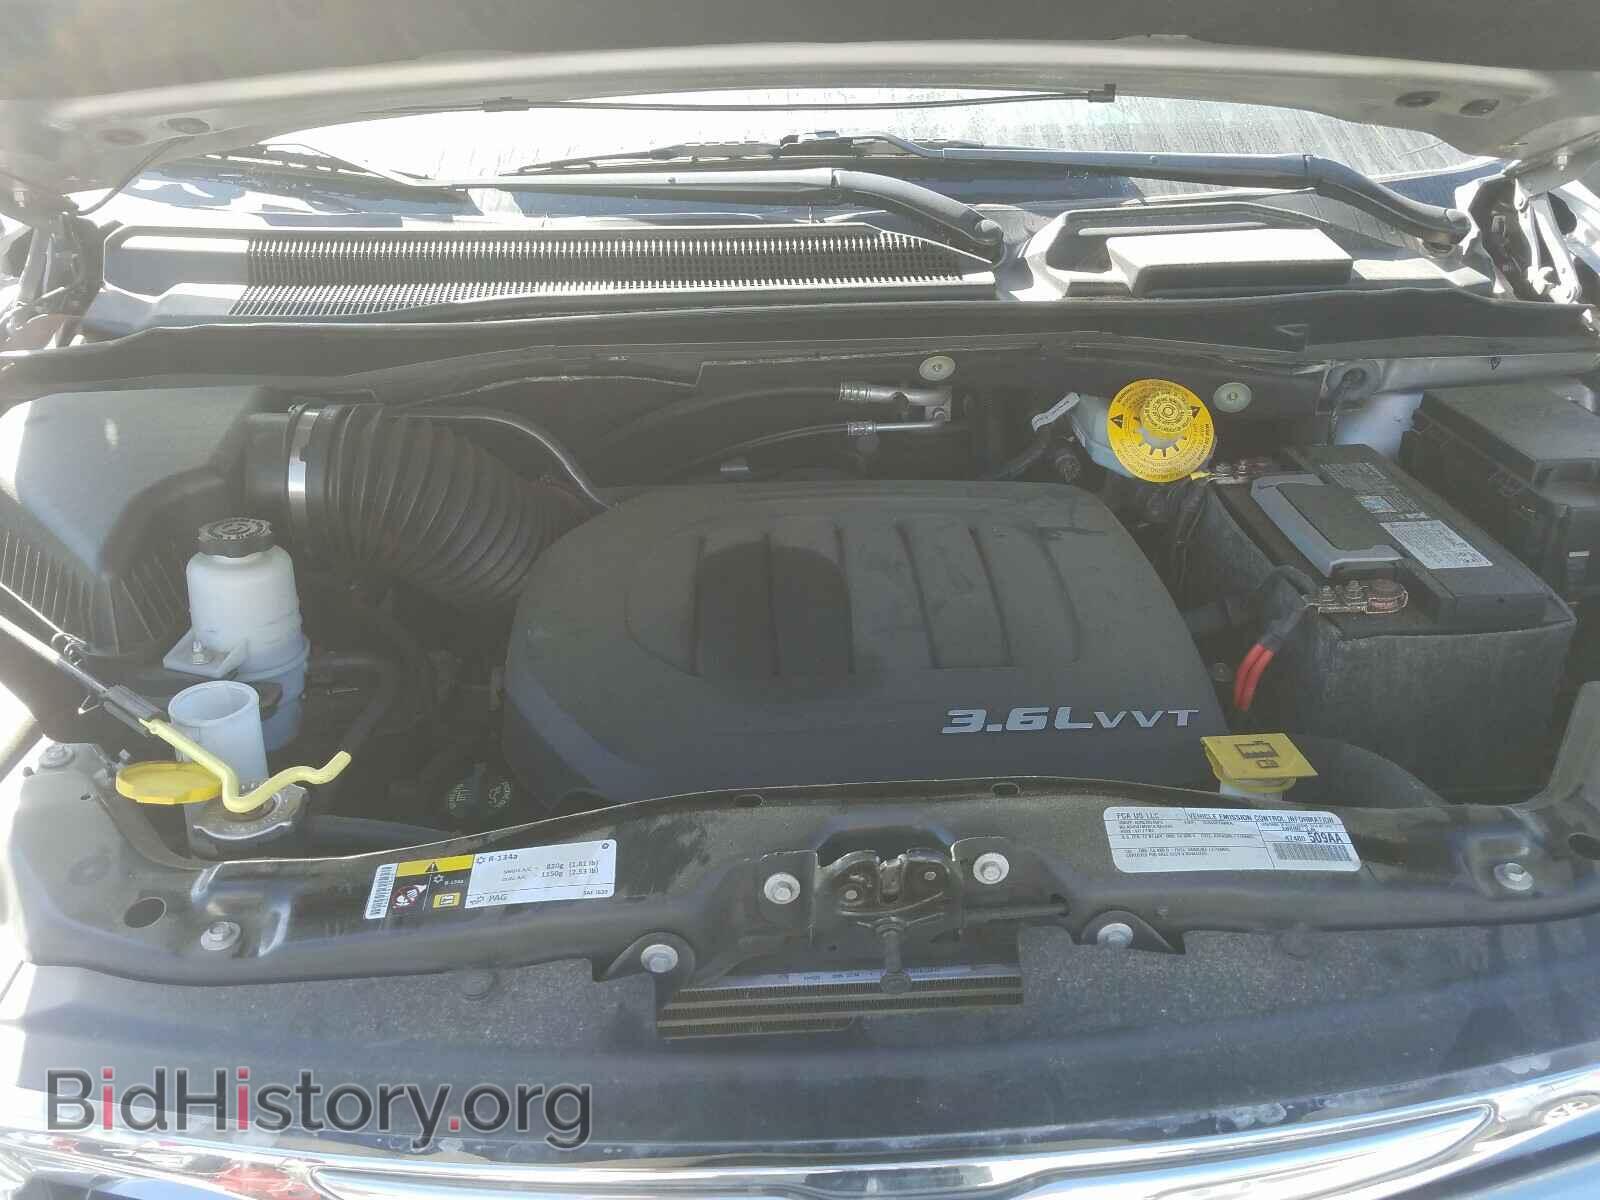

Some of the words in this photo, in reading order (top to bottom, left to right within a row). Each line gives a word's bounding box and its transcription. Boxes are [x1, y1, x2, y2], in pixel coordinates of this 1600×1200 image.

[1254, 814, 1284, 822] CONTROL
[1287, 815, 1334, 824] INFORMATION
[1308, 831, 1344, 843] 509AA
